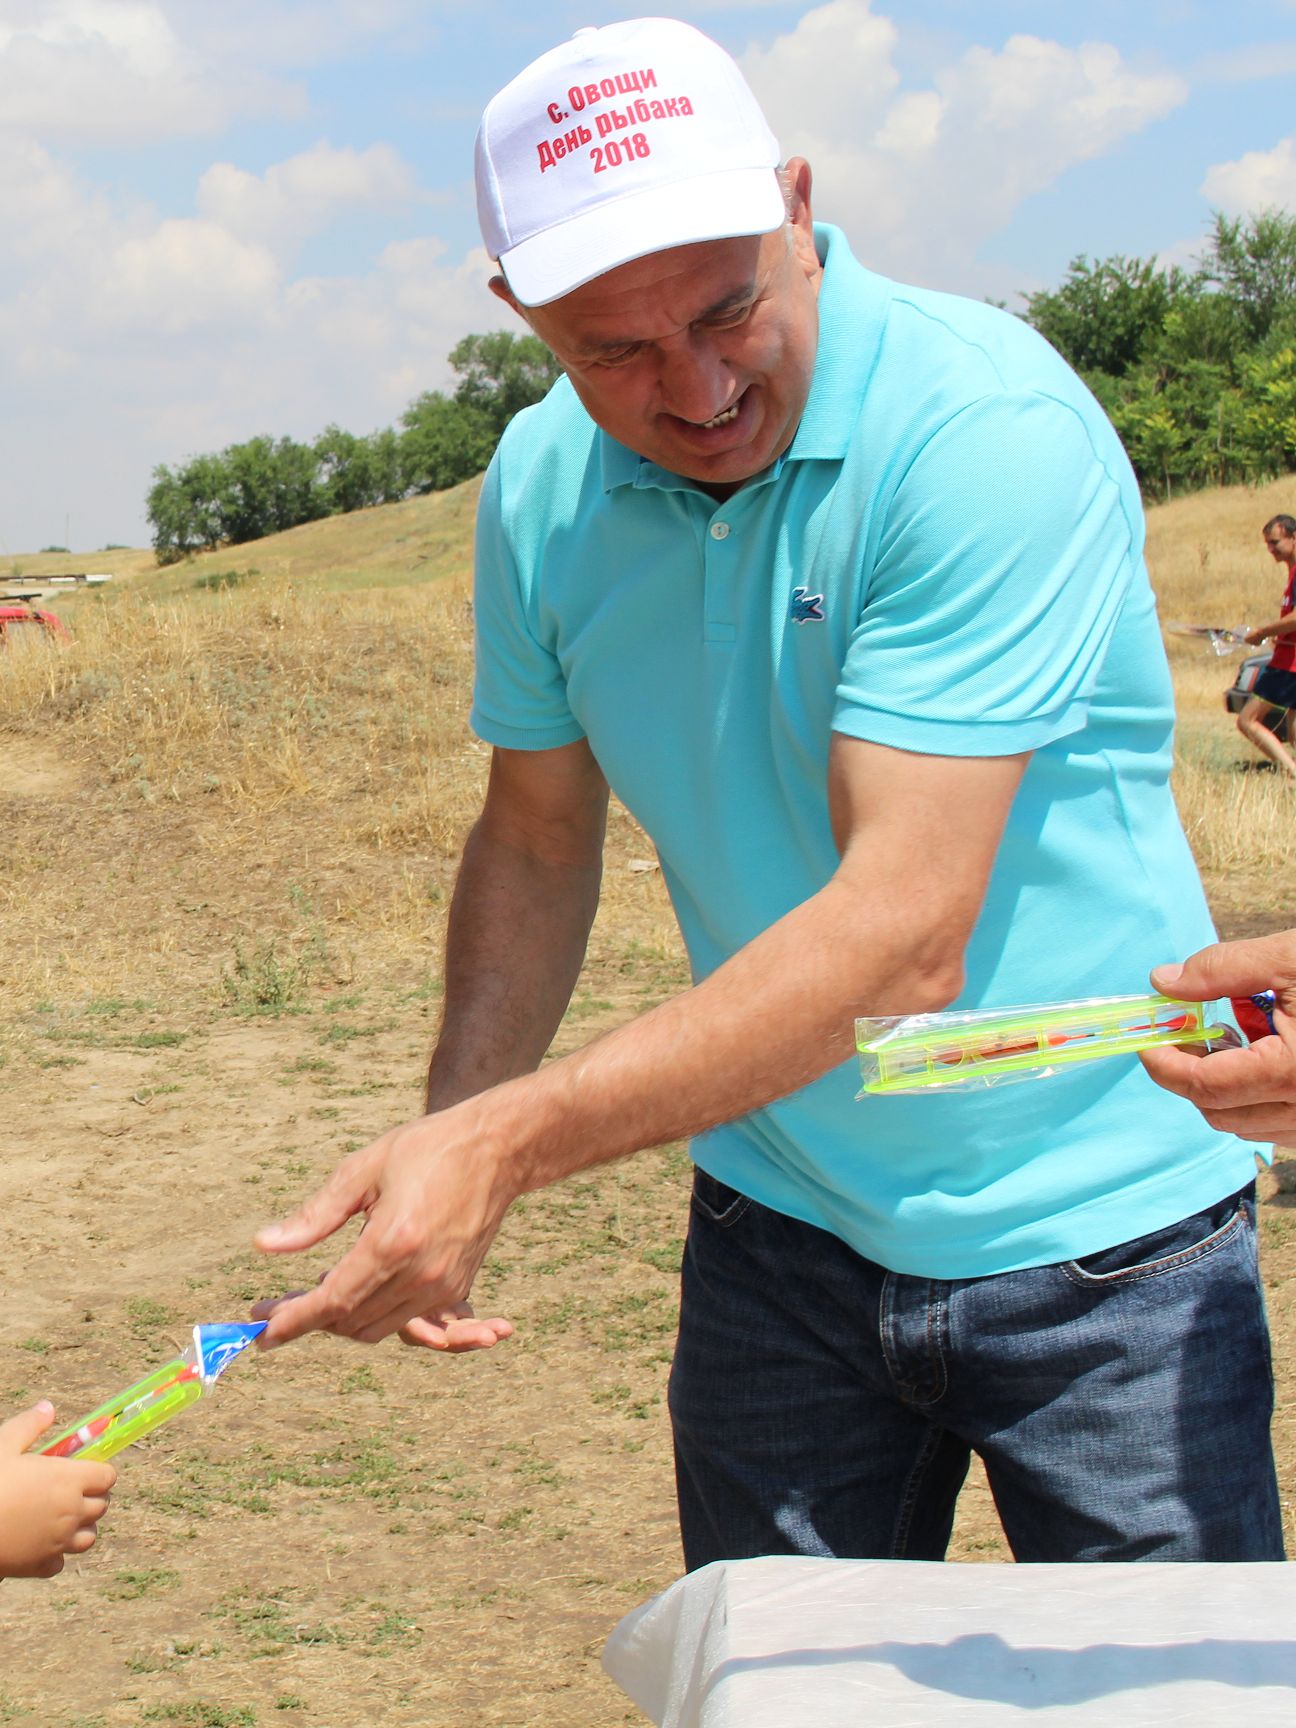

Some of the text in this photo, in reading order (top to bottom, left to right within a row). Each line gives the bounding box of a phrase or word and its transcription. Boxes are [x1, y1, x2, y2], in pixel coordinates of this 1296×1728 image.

[568, 68, 658, 111] Овощи
[536, 96, 694, 173] День рыбака
[589, 132, 651, 173] 2018
